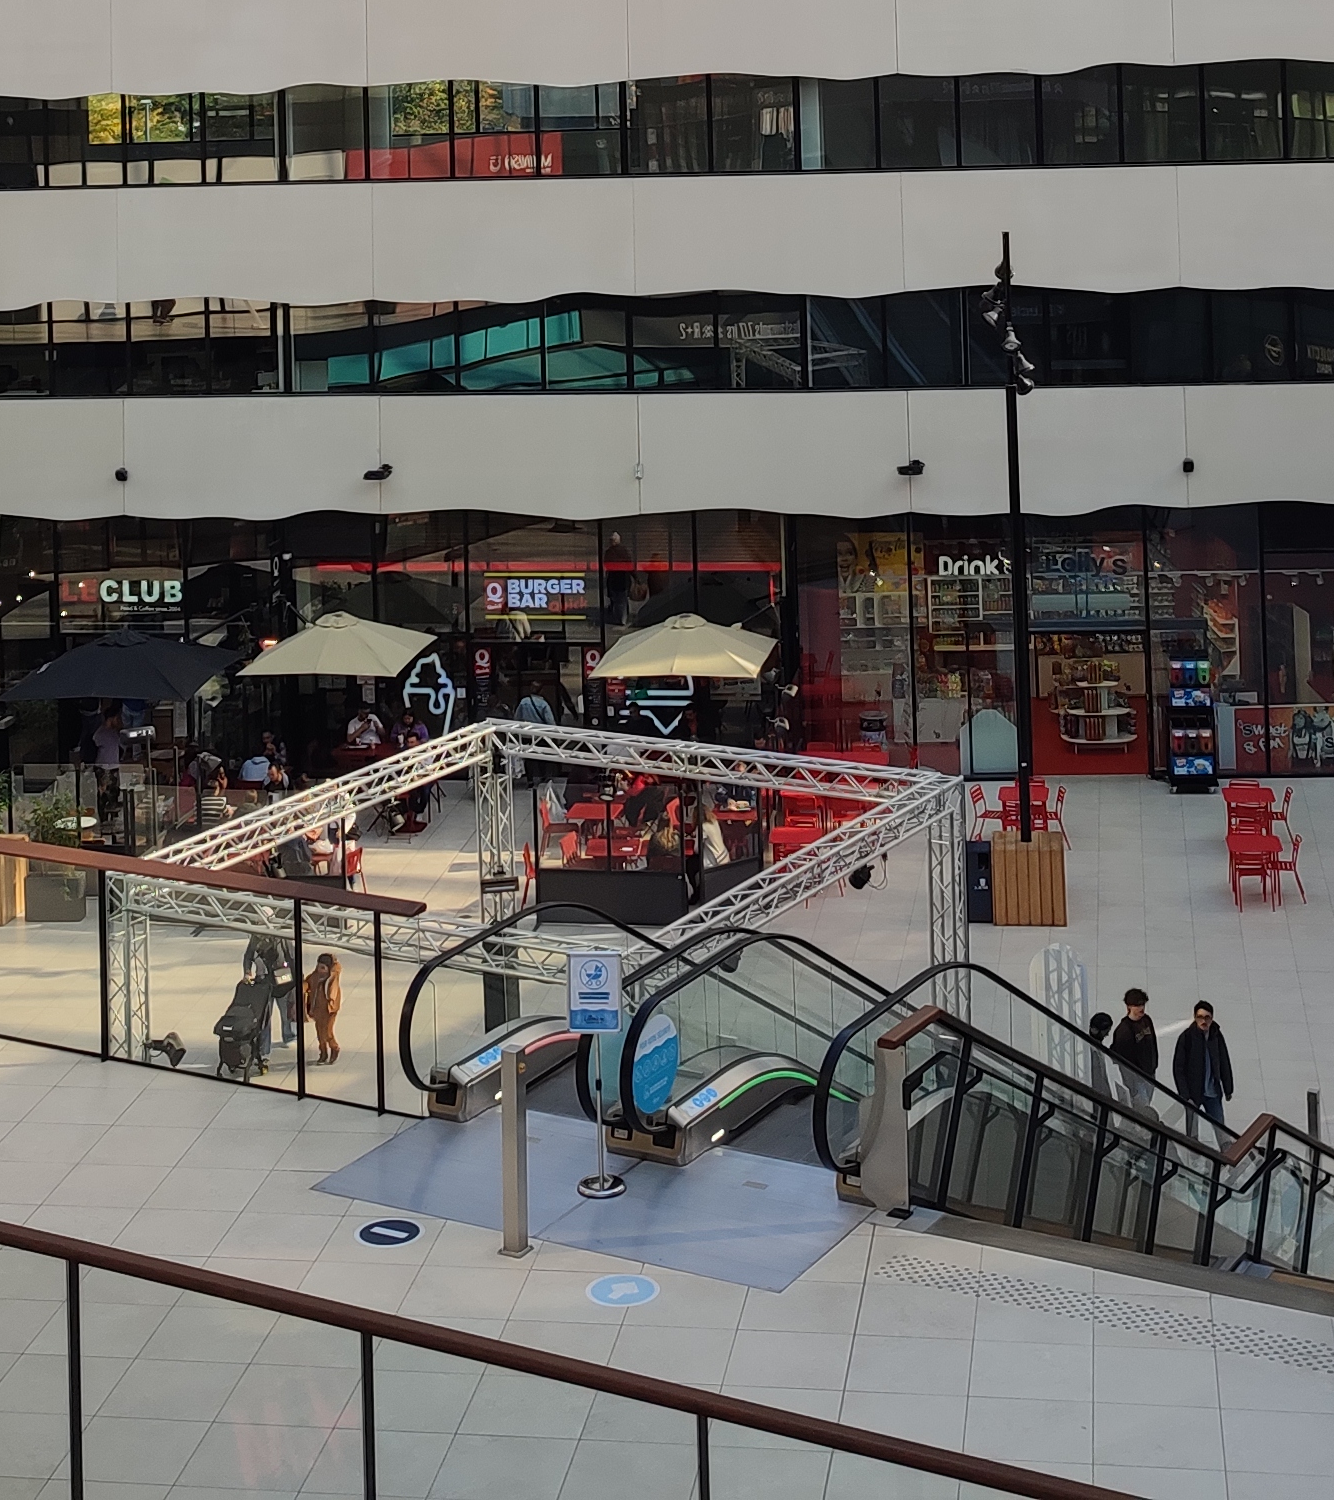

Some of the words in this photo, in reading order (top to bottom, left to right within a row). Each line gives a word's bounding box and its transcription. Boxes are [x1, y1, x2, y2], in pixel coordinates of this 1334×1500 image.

[99, 579, 183, 603] CLUB
[508, 579, 585, 594] BURGER
[508, 594, 548, 608] BAR
